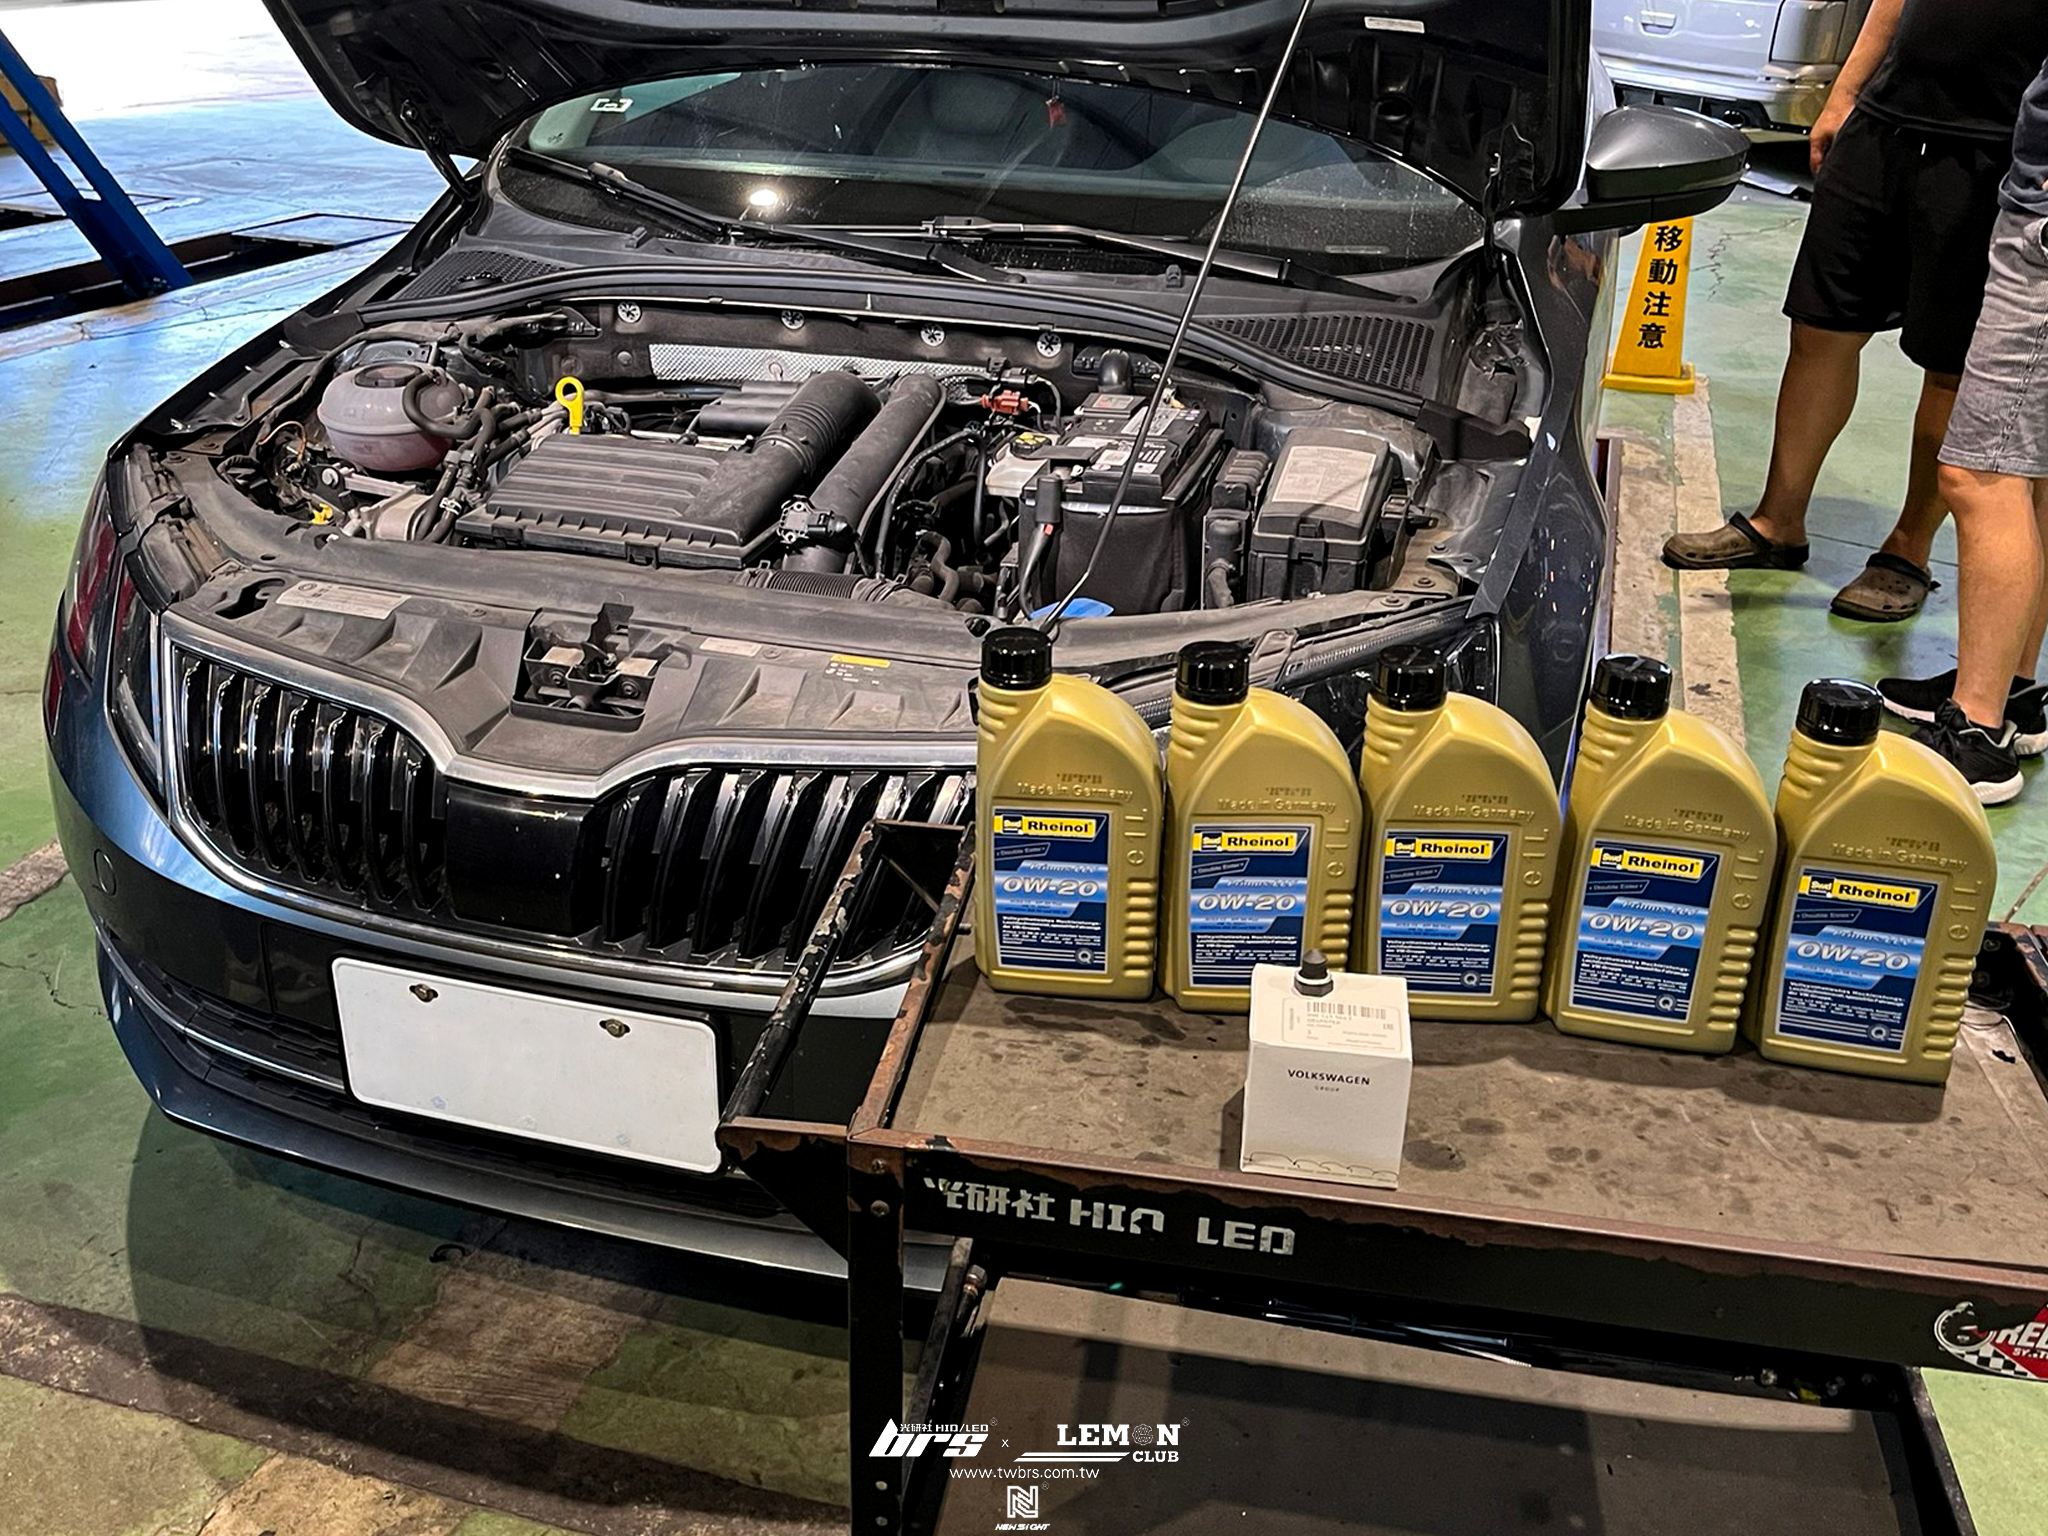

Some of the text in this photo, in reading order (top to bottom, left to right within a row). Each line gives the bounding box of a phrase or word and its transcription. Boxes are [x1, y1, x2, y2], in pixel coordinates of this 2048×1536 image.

[1637, 225, 1684, 349] 移動注意
[1018, 782, 1133, 802] Made in Germany
[1218, 798, 1336, 814] Made in Germany
[1413, 805, 1534, 822] Made in Germany
[1028, 821, 1088, 833] Rheinol
[1624, 815, 1662, 828] Made
[1667, 818, 1679, 829] in
[1683, 820, 1750, 842] Germany
[1227, 837, 1289, 847] Rheinol
[1421, 843, 1485, 854] Rheinol
[1628, 856, 1695, 873] Rheinol
[1832, 843, 1873, 858] Made
[1879, 848, 1892, 859] in
[1897, 849, 1968, 873] Germany
[1003, 877, 1099, 897] 0W-20
[1838, 885, 1911, 902] Rheinol
[1199, 894, 1296, 912] 0W-20
[1390, 900, 1492, 918] 0W-20
[1589, 914, 1695, 941] 0W-20
[1797, 941, 1910, 970] 0W-20
[1287, 1068, 1371, 1086] VOLKSWAGEN
